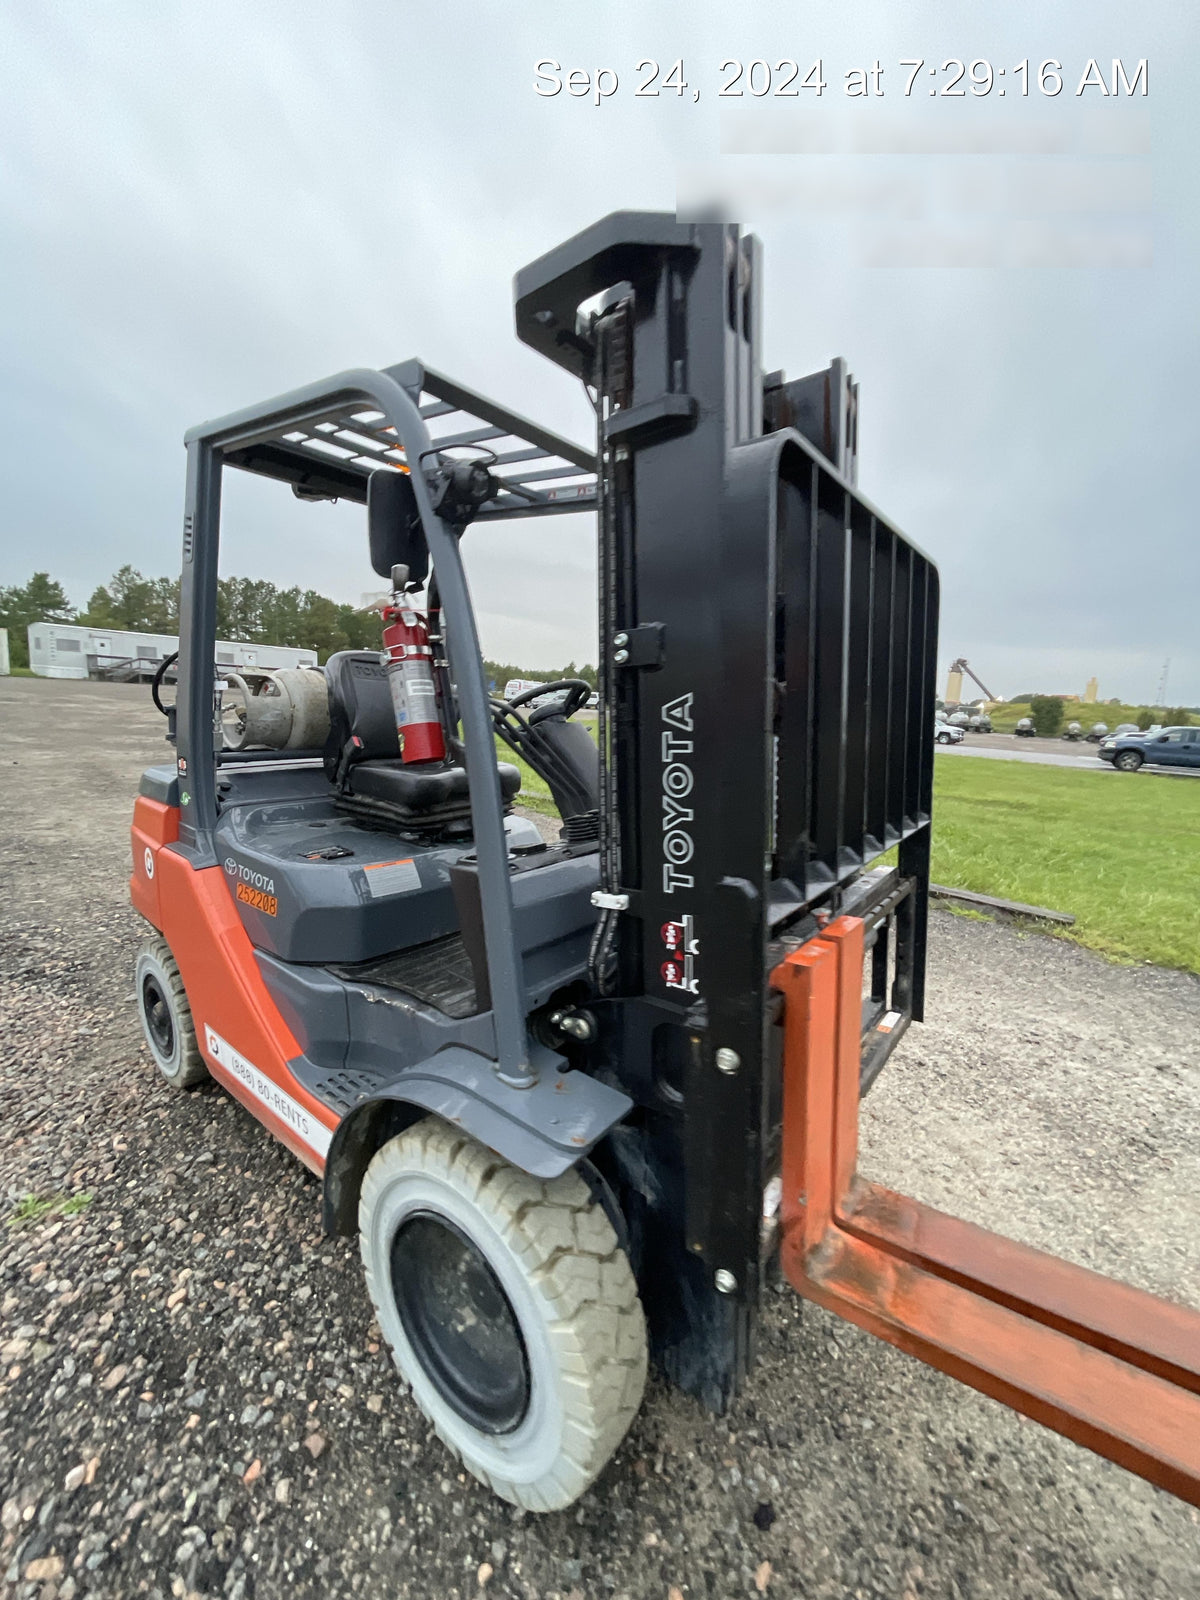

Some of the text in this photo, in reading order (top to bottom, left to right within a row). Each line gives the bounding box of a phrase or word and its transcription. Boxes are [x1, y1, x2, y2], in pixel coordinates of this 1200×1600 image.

[661, 691, 695, 894] TOYOTA
[237, 883, 277, 915] 252208
[238, 864, 275, 894] TOYOTA
[232, 1056, 309, 1134] (888) 80-RENTS
